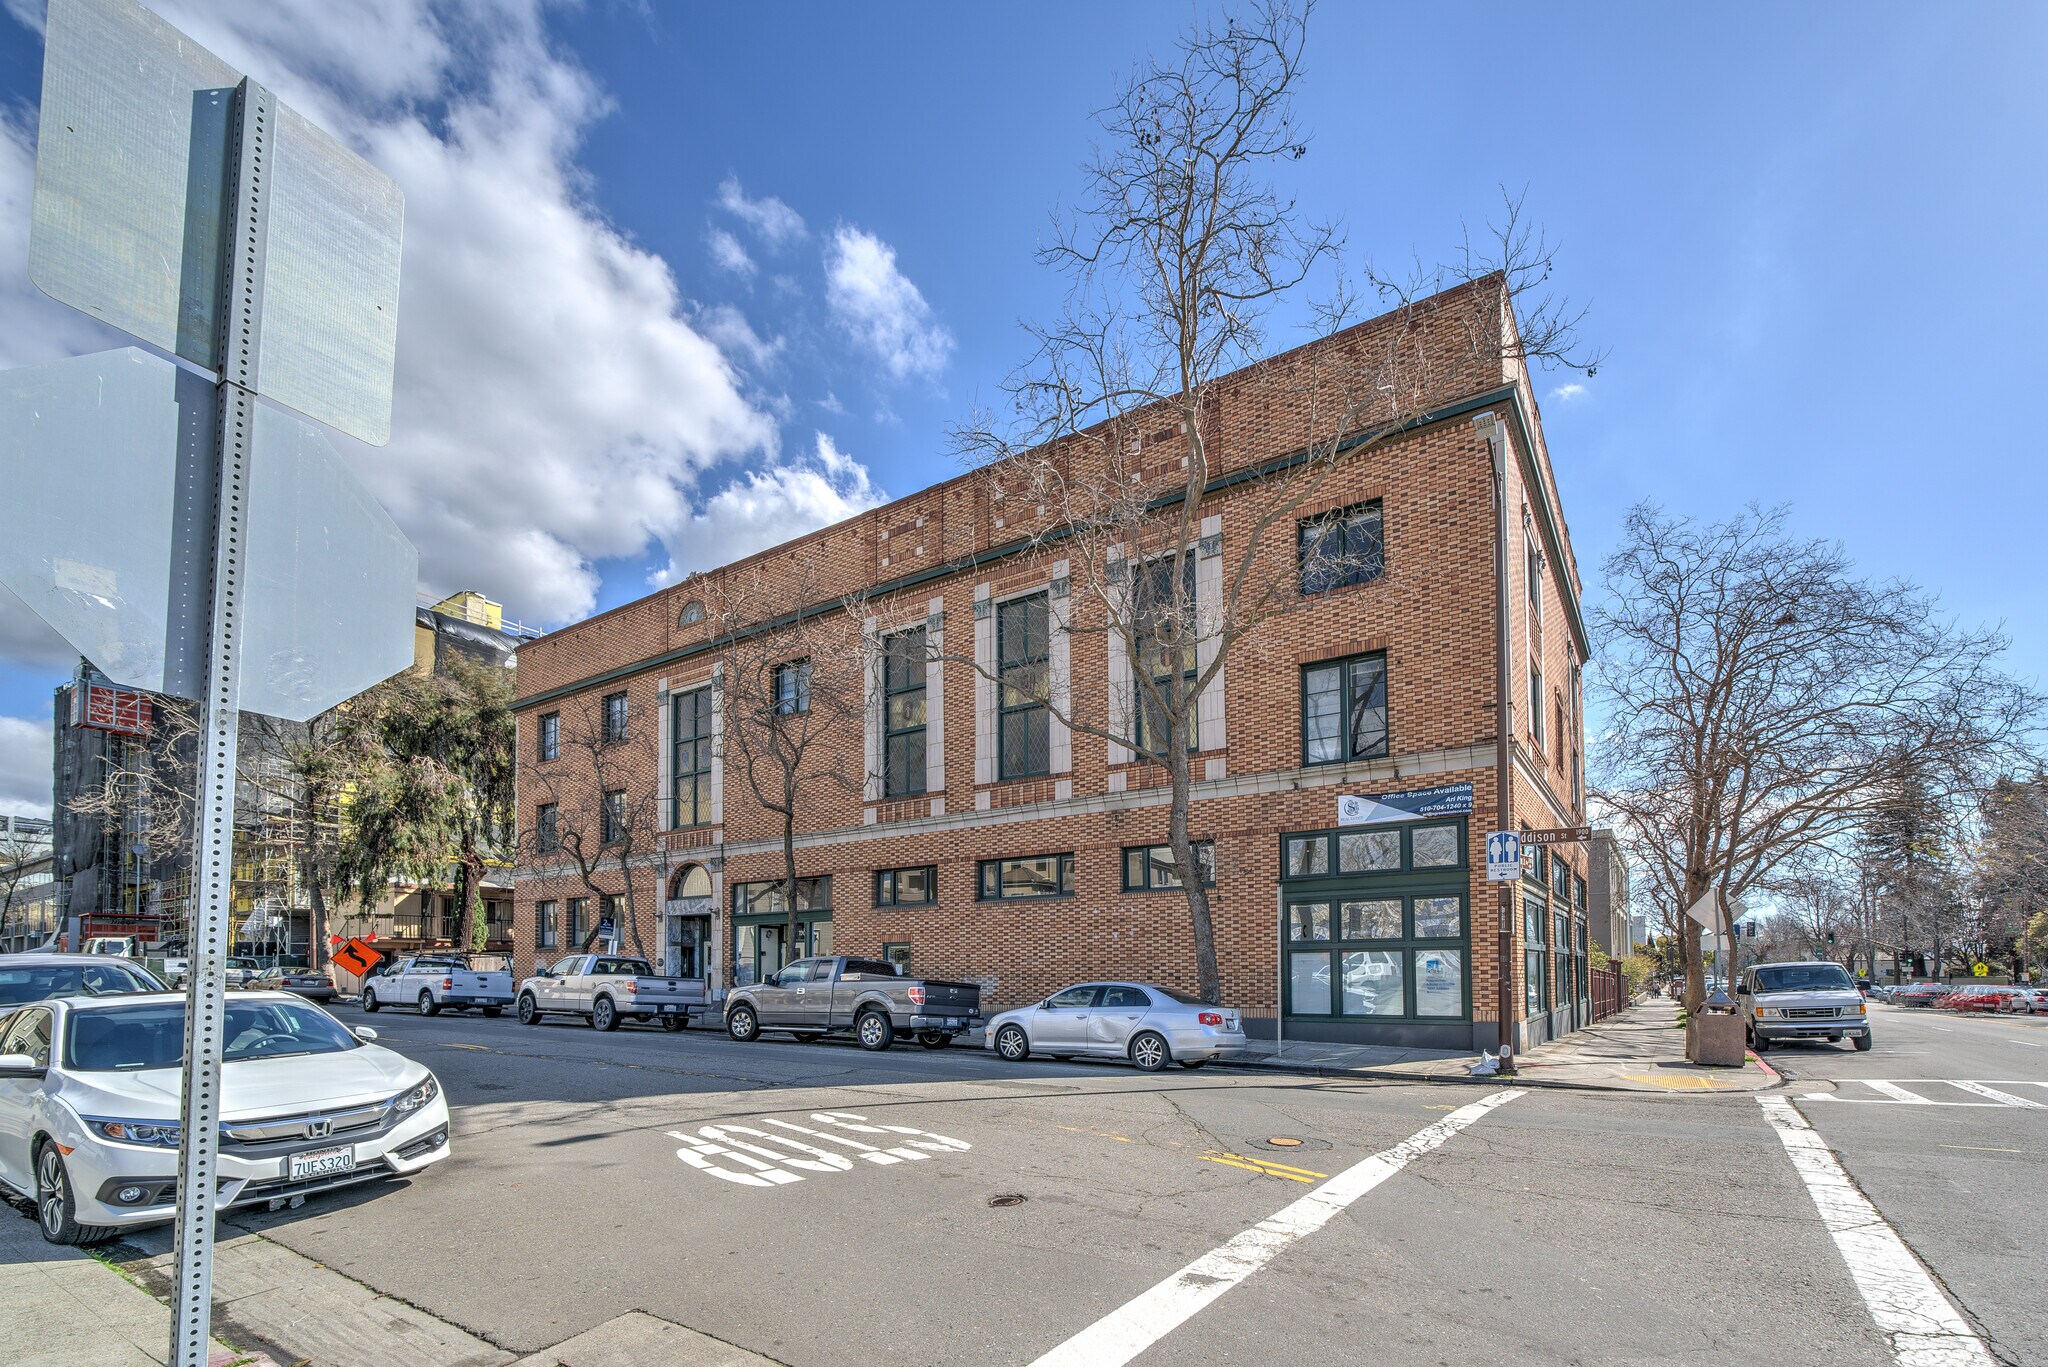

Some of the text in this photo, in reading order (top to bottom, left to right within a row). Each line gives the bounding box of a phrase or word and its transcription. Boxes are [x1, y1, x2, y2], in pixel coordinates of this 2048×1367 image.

[1433, 784, 1472, 795] Available
[1420, 803, 1461, 812] 510-704-1240
[1520, 831, 1556, 843] ddison
[294, 1154, 351, 1176] 7UES320
